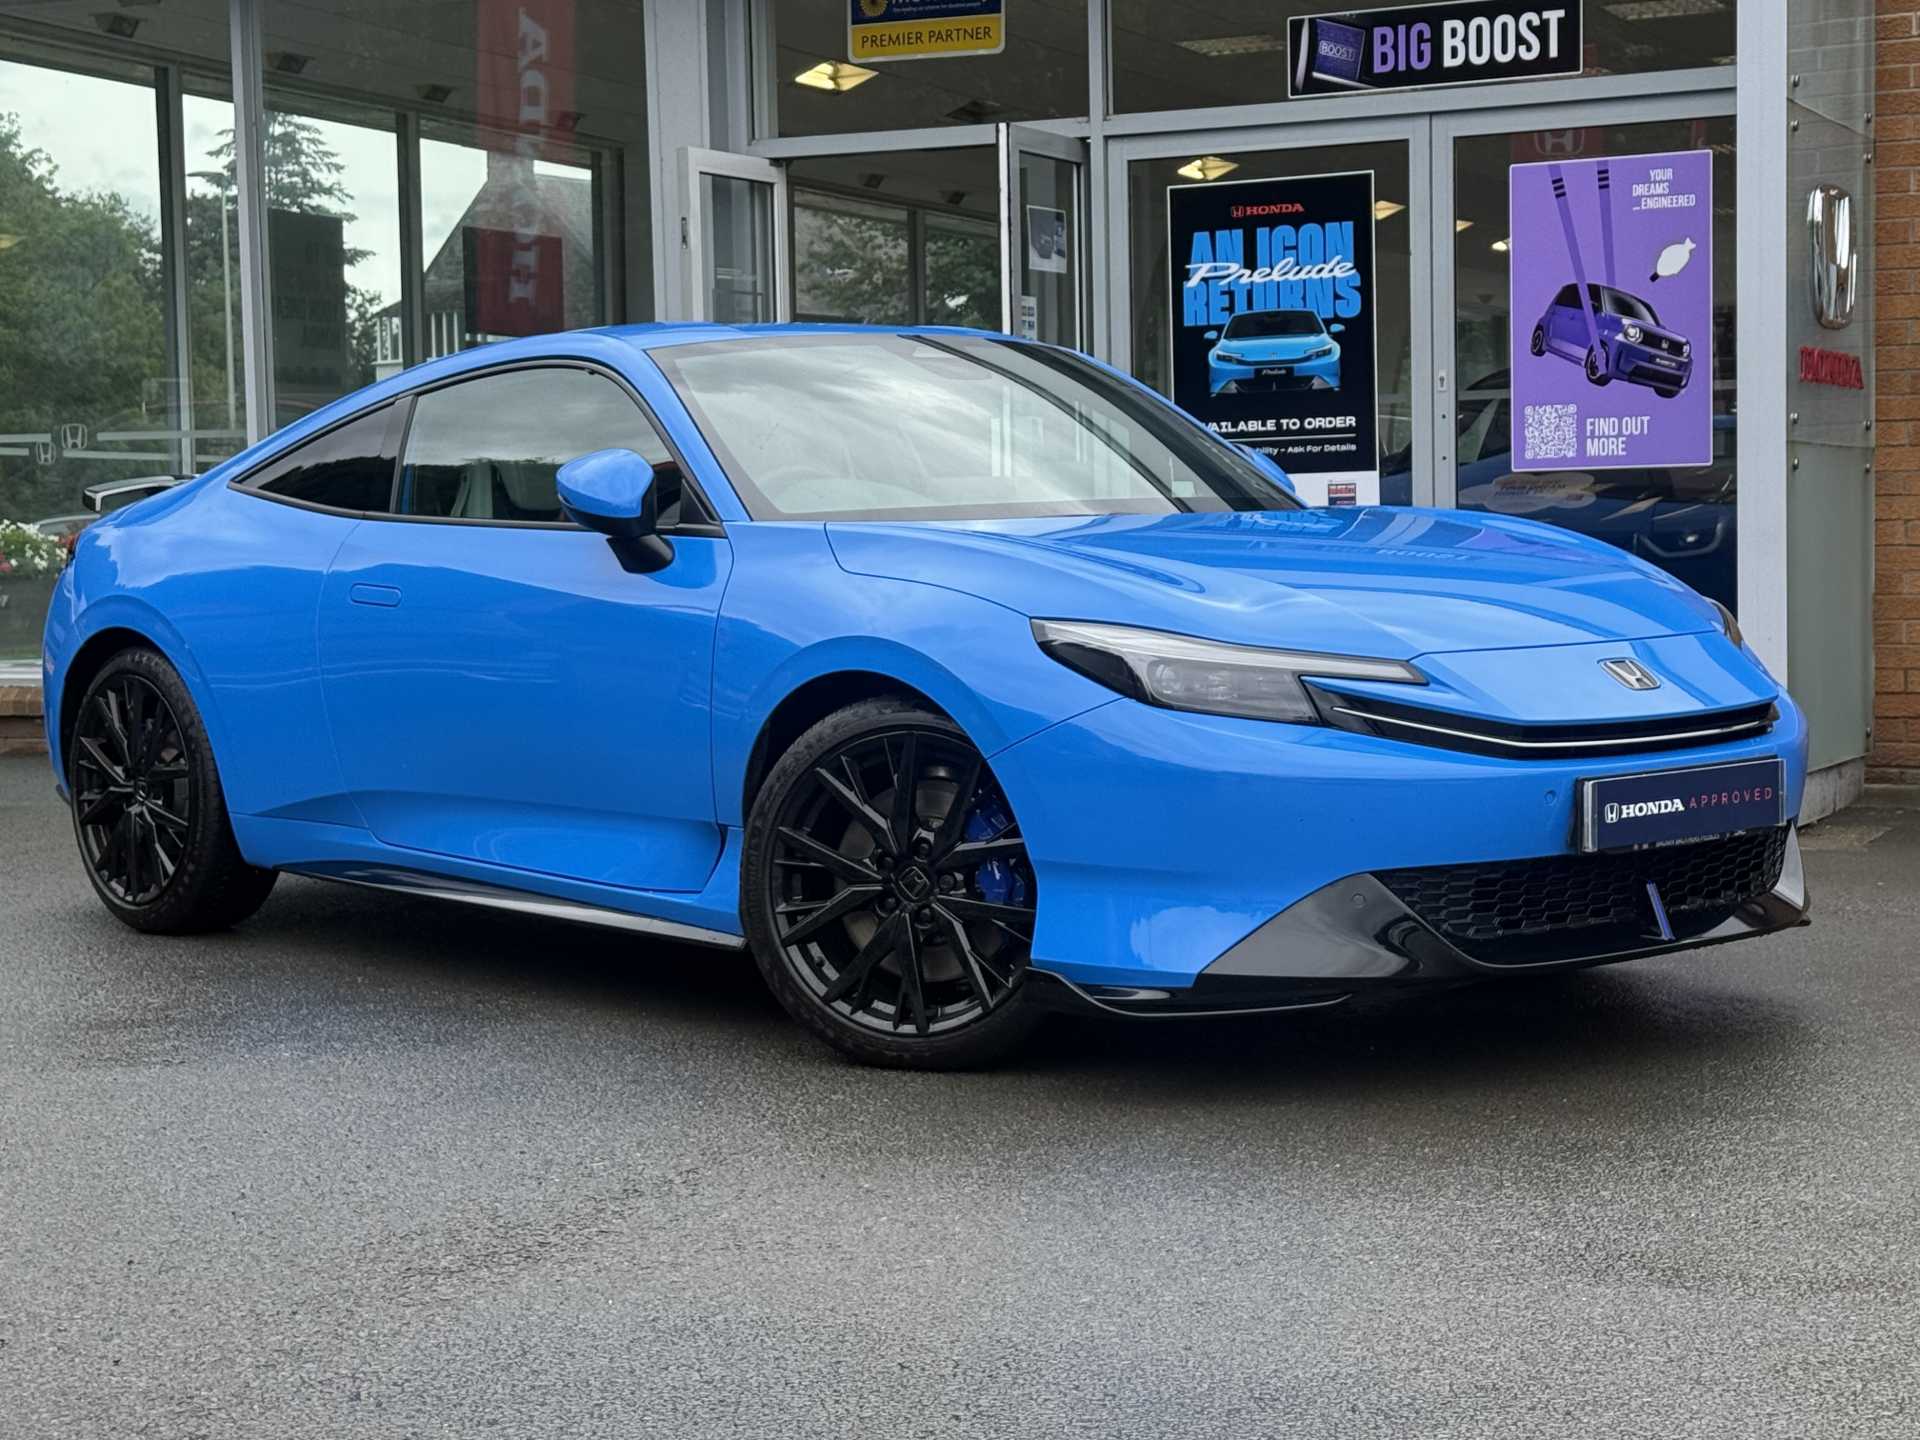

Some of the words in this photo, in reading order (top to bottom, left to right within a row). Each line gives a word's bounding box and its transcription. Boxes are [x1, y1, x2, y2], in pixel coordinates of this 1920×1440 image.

[861, 31, 924, 48] PREMIER
[928, 26, 992, 43] PARTNER
[1373, 22, 1432, 73] BIG
[1443, 9, 1566, 68] BOOST
[1650, 168, 1673, 181] YOUR
[1632, 183, 1669, 196] DREAMS
[1246, 203, 1304, 216] HONDA
[1190, 229, 1244, 277] AN
[1256, 221, 1354, 271] ICON
[1185, 255, 1357, 288] Prelude
[1183, 272, 1362, 327] RETURNS
[1280, 418, 1300, 430] TO
[1304, 416, 1356, 429] ORDER
[1586, 418, 1618, 437] FIND
[1622, 416, 1650, 435] OUT
[1306, 444, 1322, 453] For
[1324, 442, 1357, 452] Details
[1586, 437, 1627, 457] MORE
[1621, 798, 1685, 818] HONDA
[1690, 787, 1773, 808] APPROVED
